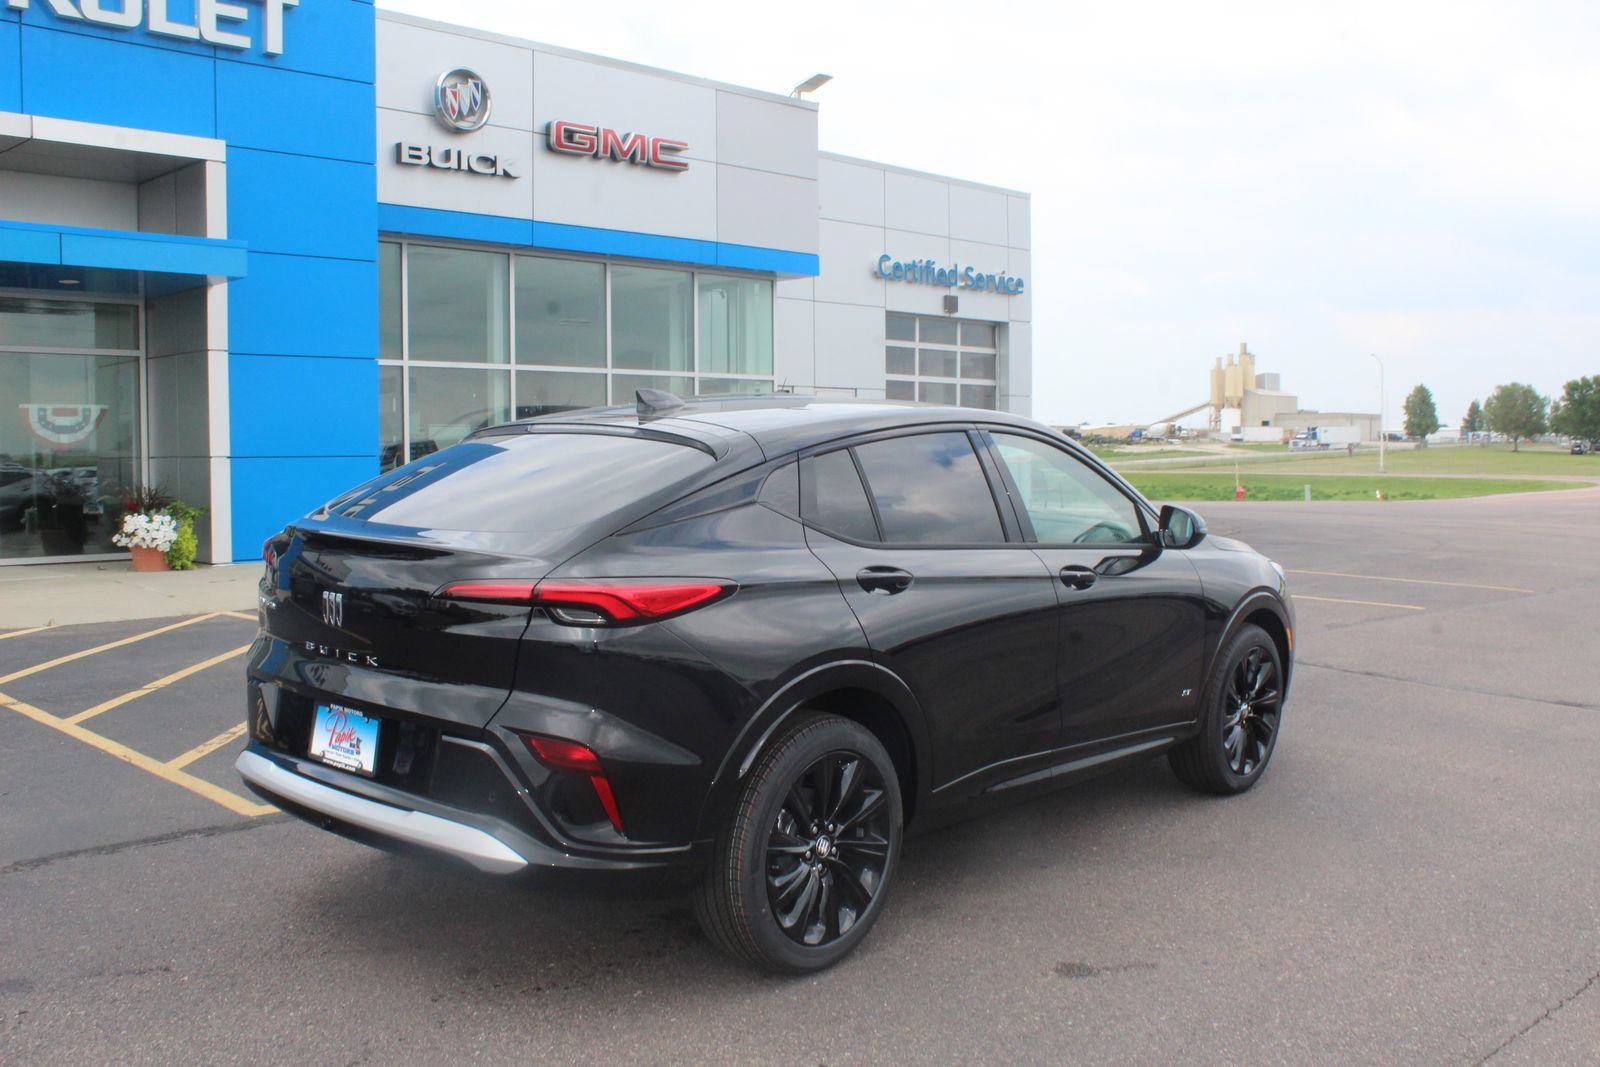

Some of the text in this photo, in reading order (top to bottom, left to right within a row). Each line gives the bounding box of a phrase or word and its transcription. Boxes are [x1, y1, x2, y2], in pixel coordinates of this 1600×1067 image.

[396, 142, 520, 179] BUICK
[547, 120, 690, 171] GMC
[878, 253, 1025, 294] Certified Service
[305, 641, 378, 667] BUICK
